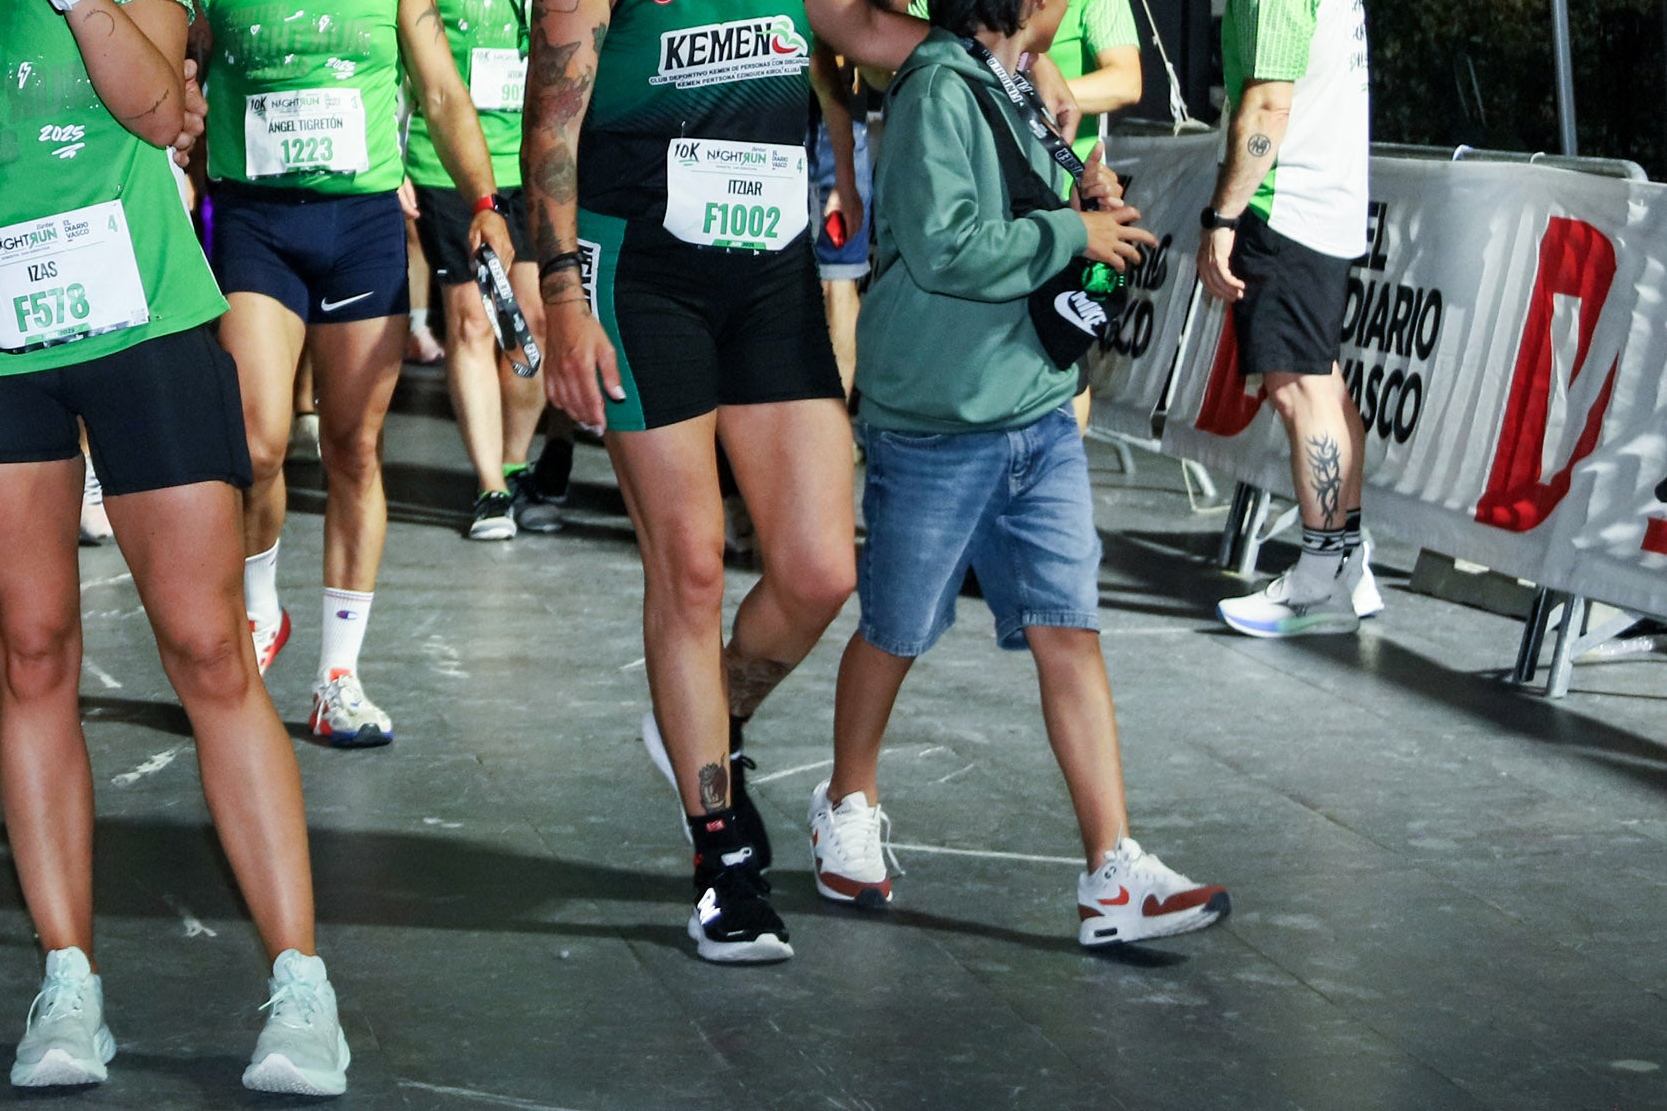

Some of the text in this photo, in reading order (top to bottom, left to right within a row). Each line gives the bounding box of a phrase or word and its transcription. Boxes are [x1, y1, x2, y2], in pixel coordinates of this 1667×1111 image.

[664, 22, 772, 71] KEMEN
[669, 71, 707, 82] DEPORTIVO
[709, 67, 730, 75] KEMEN
[740, 62, 771, 71] PERSONAS
[501, 83, 524, 102] 90
[250, 96, 268, 112] 10K
[38, 124, 85, 142] 2025
[268, 116, 343, 134] ÁNGEL TIGRETÓN
[280, 136, 334, 164] 1223
[674, 141, 701, 163] 10K
[796, 157, 803, 174] 4
[727, 179, 763, 197] ITZIAR
[64, 221, 89, 233] DIARIO
[107, 214, 119, 233] 4
[702, 202, 781, 239] F1002
[66, 228, 90, 239] VASCO
[27, 260, 59, 283] IZAS
[12, 282, 91, 334] F578
[1070, 290, 1108, 327] NIKE
[1341, 277, 1442, 362] DIARIO
[1342, 358, 1423, 444] ASCO
